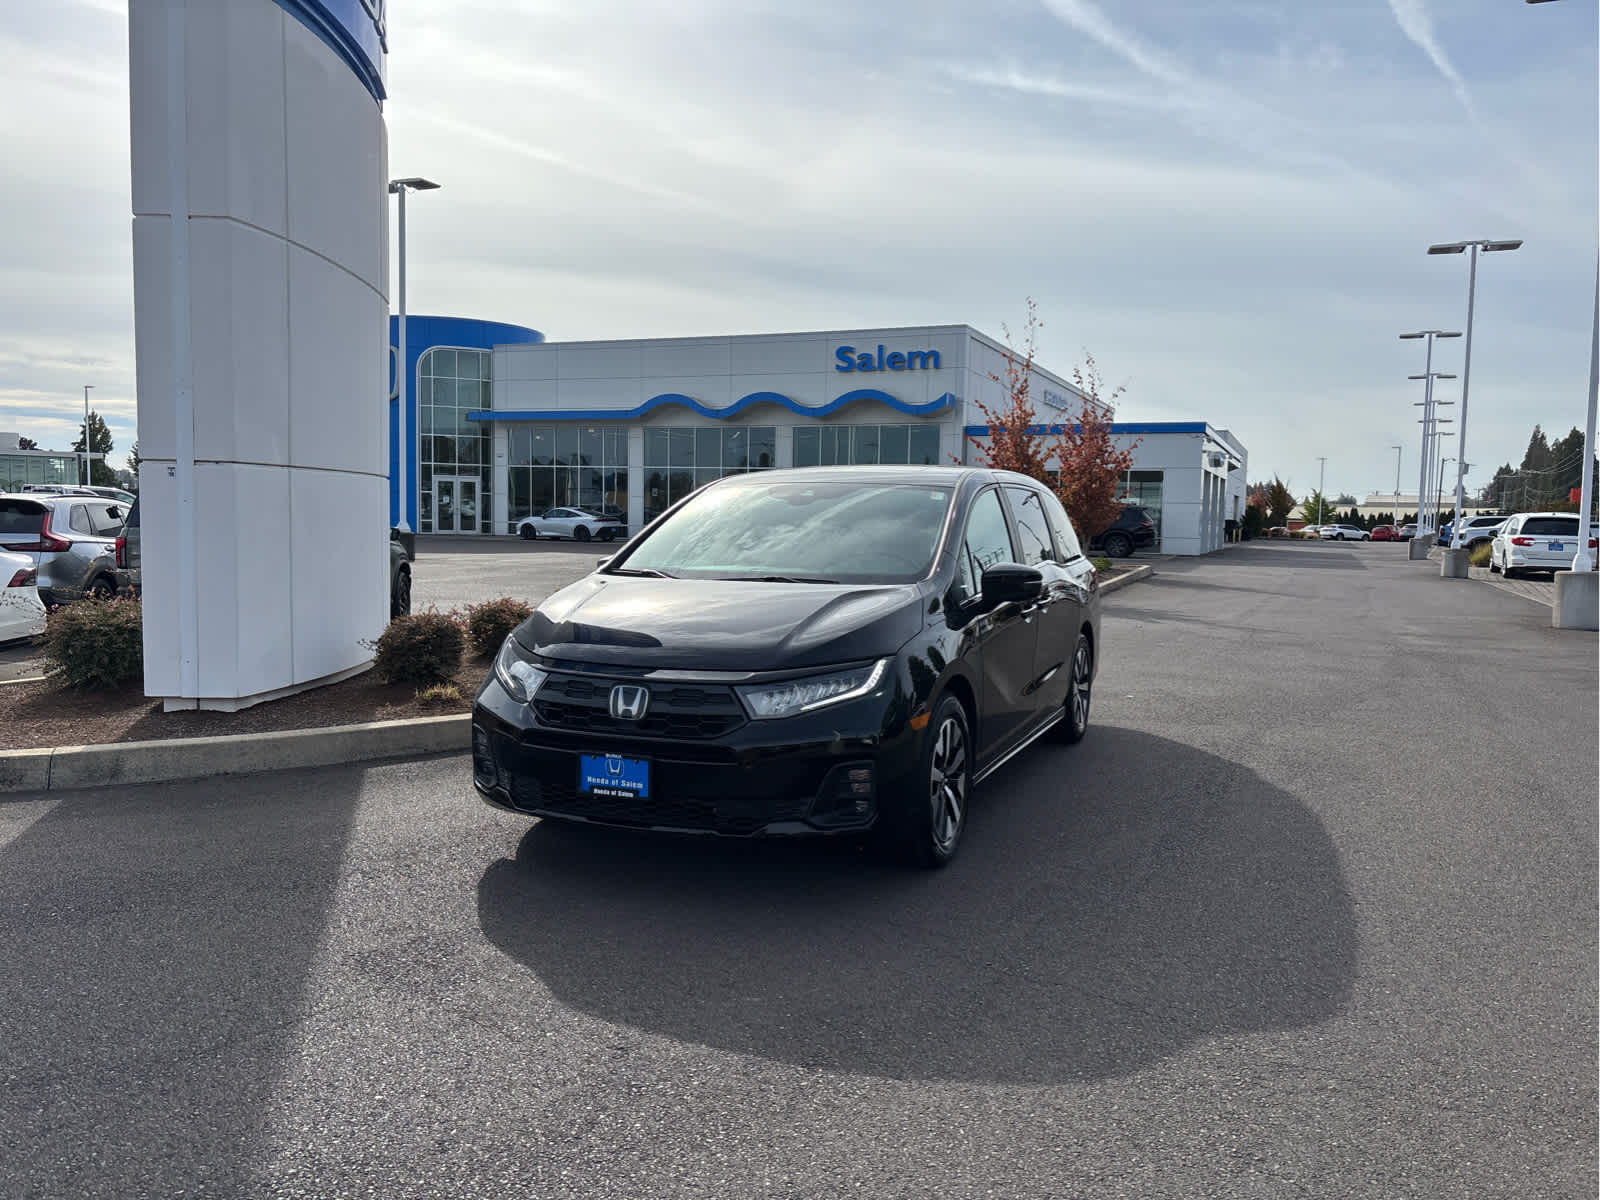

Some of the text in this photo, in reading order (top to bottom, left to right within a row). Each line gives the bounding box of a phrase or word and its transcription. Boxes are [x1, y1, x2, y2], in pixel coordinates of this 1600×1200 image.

[835, 344, 941, 372] Salem
[587, 776, 609, 785] Honda
[621, 779, 643, 789] Salem
